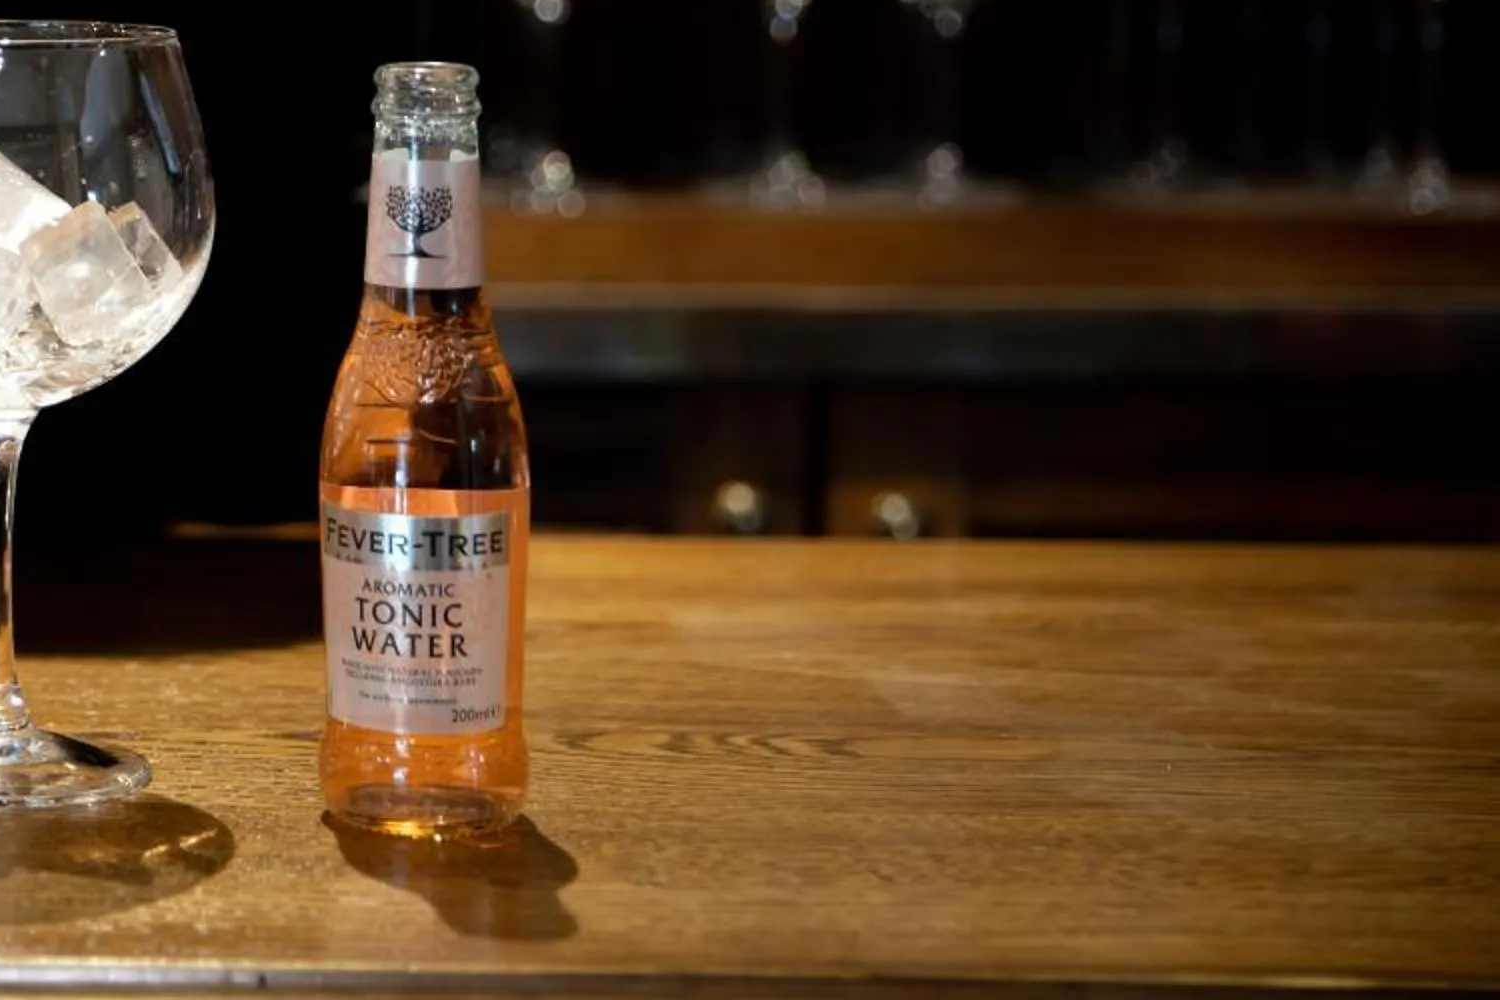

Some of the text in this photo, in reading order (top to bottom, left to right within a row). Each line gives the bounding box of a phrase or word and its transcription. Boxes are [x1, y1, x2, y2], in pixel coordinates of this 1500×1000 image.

[326, 517, 503, 557] FEVER-TREE
[361, 578, 456, 597] AROMATIC
[355, 597, 463, 628] TONIC
[351, 626, 469, 658] WATER
